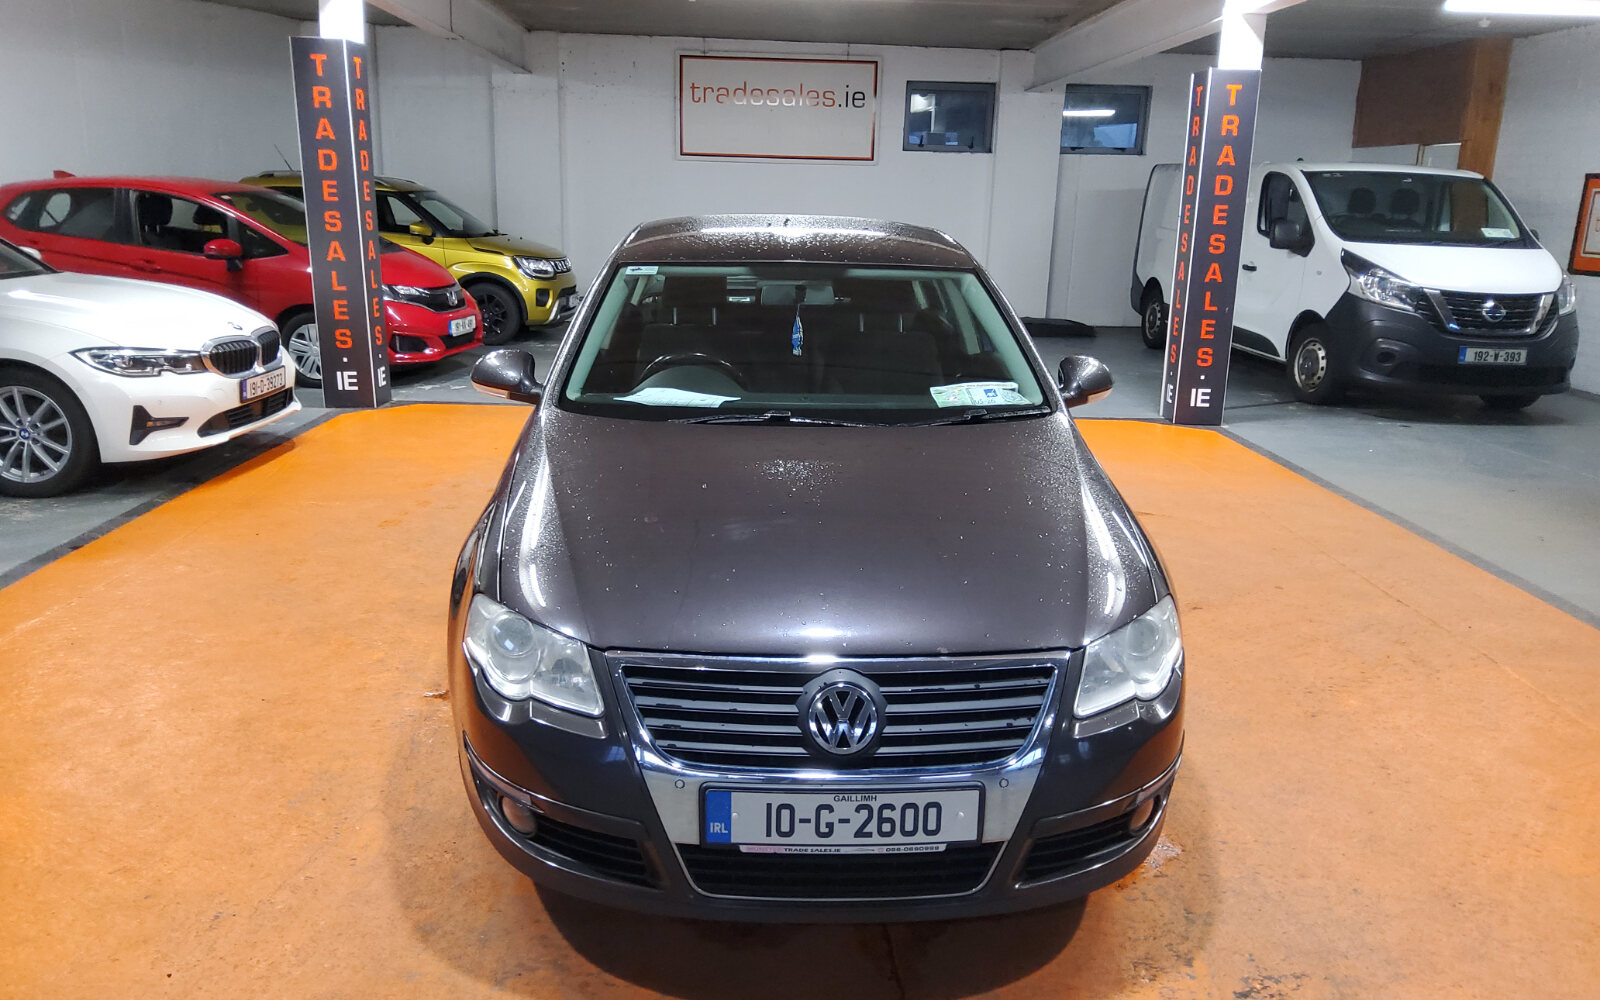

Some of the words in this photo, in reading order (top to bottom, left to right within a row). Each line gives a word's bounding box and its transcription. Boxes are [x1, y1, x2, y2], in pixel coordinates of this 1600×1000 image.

[690, 81, 866, 109] tradesales.ie
[1473, 350, 1522, 362] 192-W-393
[832, 794, 878, 803] GAILLIMH
[765, 801, 943, 839] 10-G-2600
[709, 822, 729, 834] IRL
